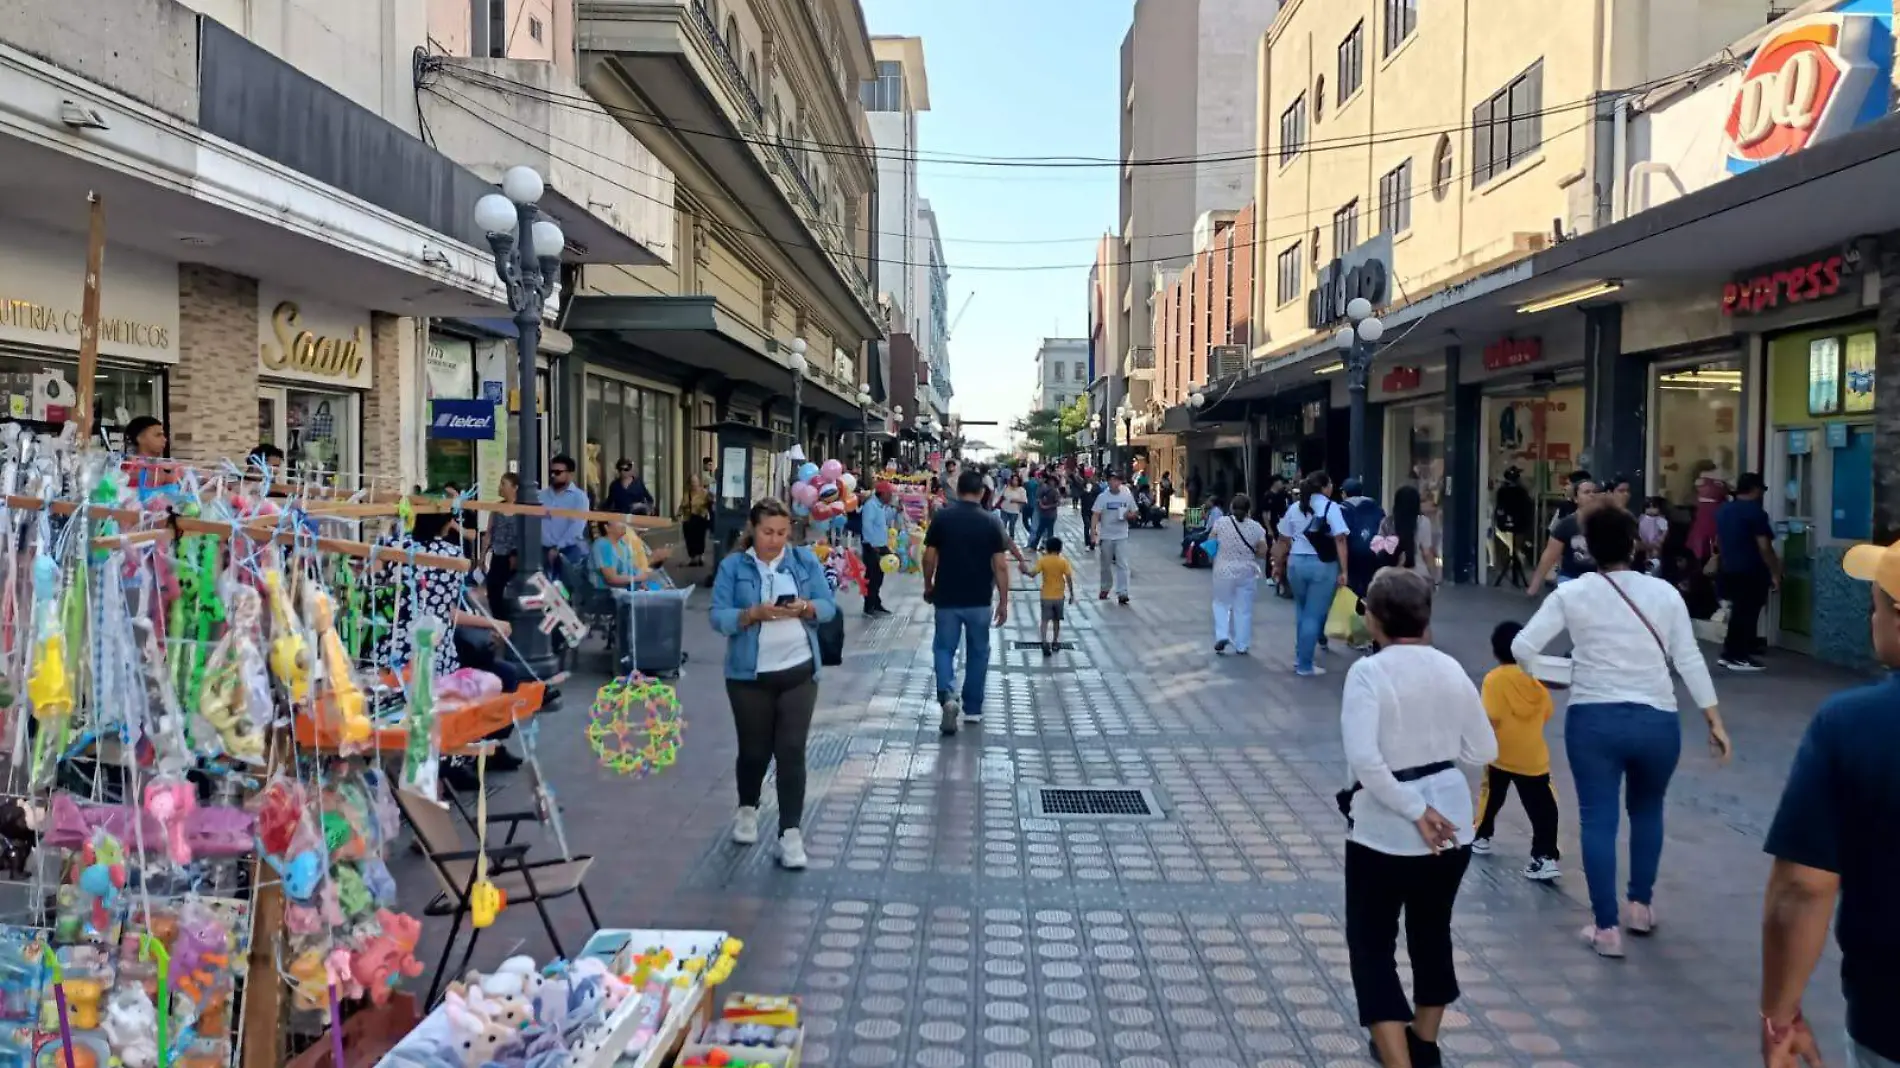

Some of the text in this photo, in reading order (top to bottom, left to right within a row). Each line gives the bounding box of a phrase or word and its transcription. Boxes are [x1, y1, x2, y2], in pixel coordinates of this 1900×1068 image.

[1737, 50, 1819, 147] DQ
[1722, 256, 1842, 316] express
[449, 415, 492, 428] telcel
